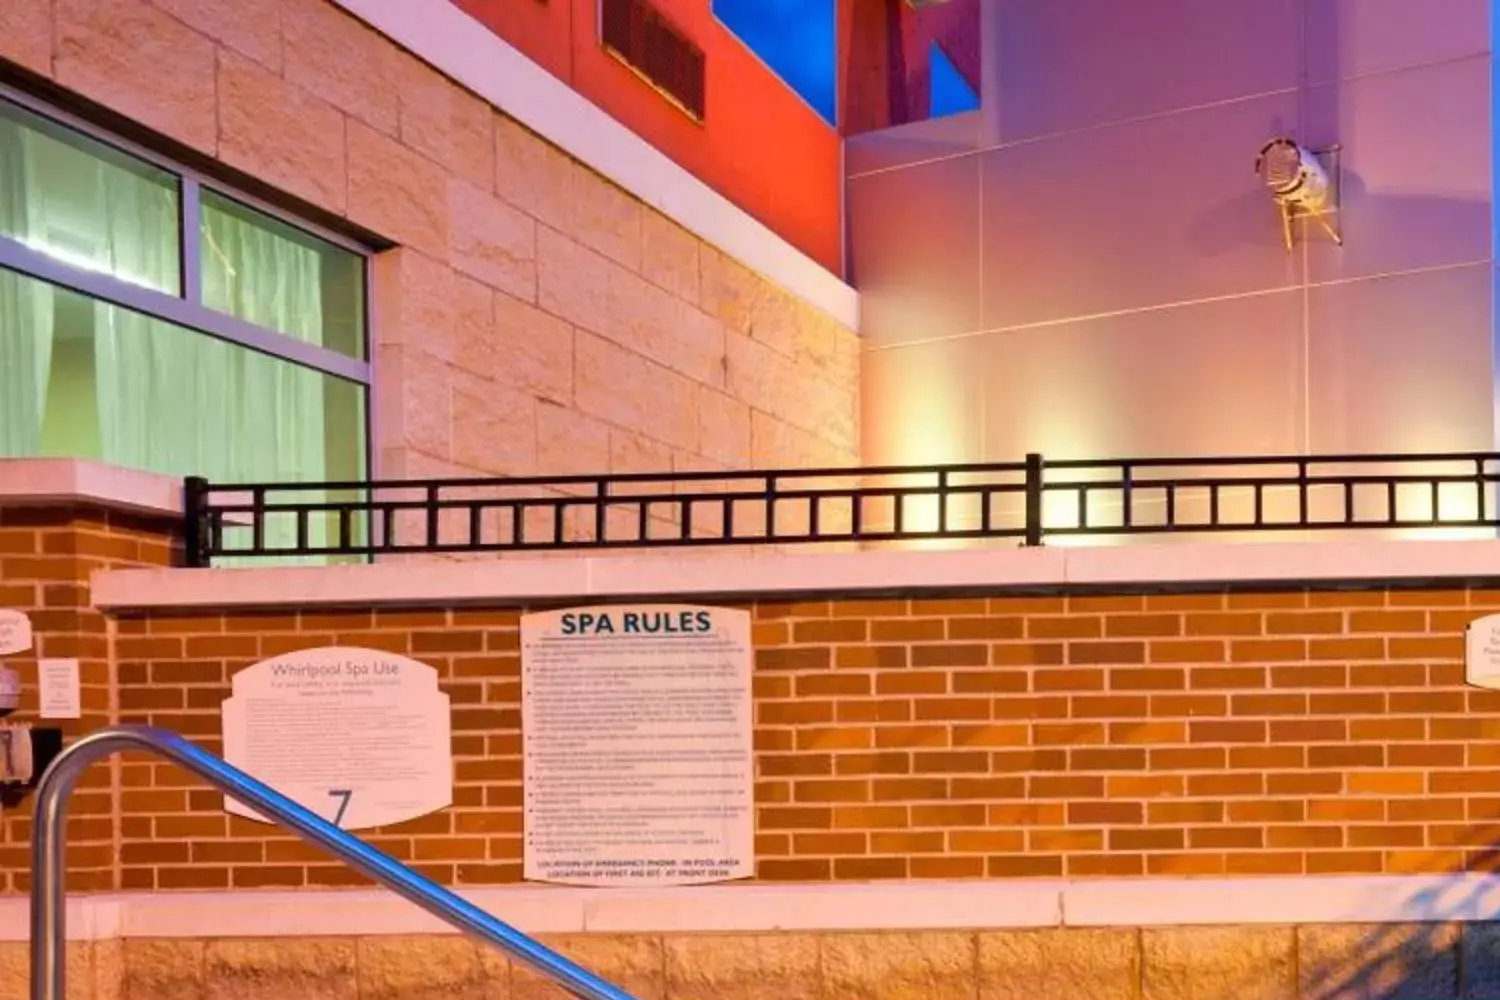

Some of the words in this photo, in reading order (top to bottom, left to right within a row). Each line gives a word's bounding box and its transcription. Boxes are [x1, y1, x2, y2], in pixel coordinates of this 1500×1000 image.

[561, 612, 614, 635] SPA
[623, 610, 711, 633] RULES
[271, 662, 341, 679] Whirlpool
[345, 660, 369, 679] Spa
[373, 660, 400, 676] Use
